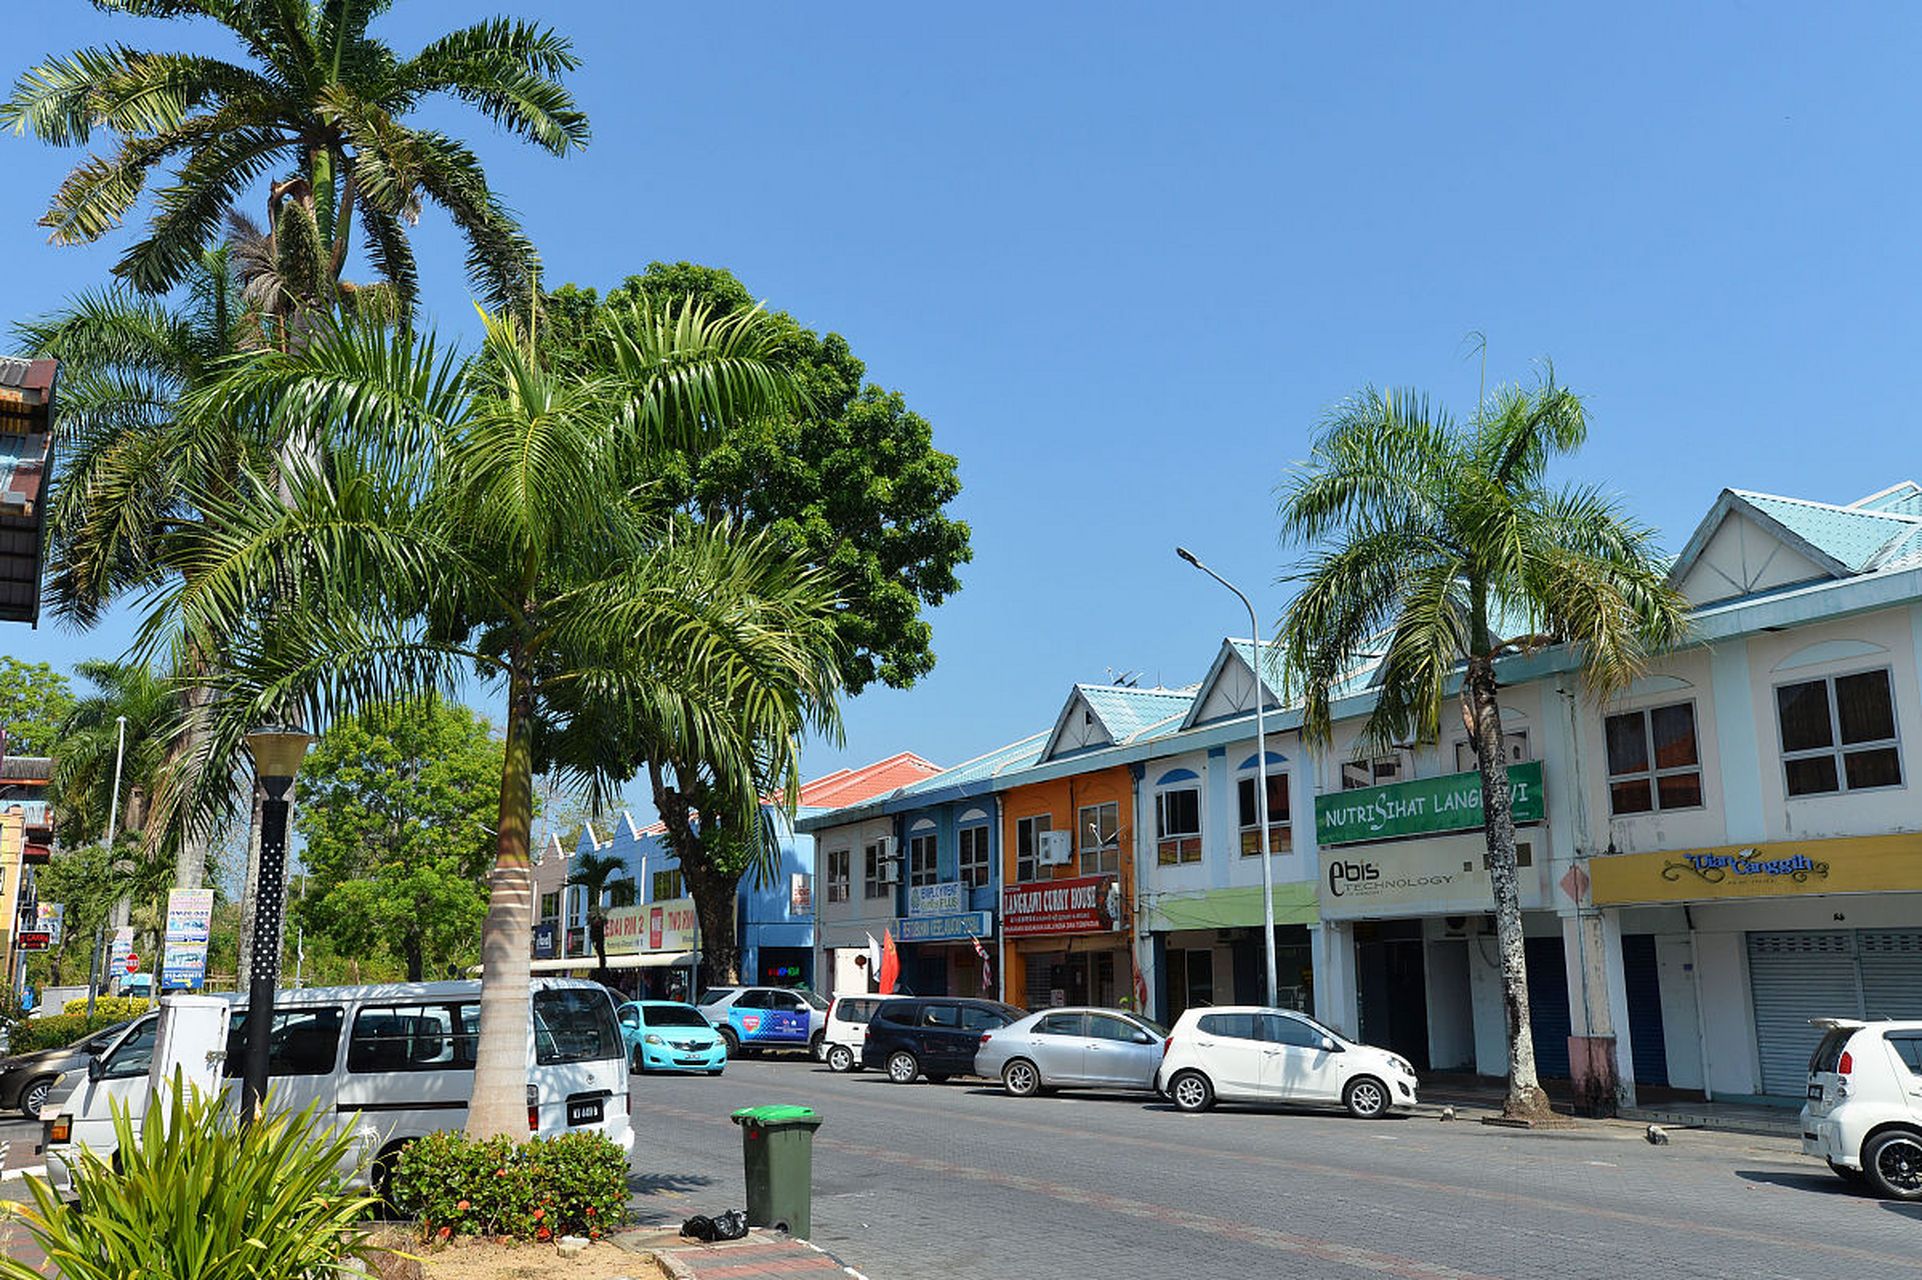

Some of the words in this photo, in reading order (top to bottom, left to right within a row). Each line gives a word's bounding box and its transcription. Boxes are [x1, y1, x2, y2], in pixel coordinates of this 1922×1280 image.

[1732, 854, 1814, 876] Canggih
[1329, 859, 1380, 897] ebis
[1343, 875, 1454, 892] TECHNOLOGY
[1043, 888, 1069, 912] CURRY
[1070, 885, 1096, 910] HOUSE
